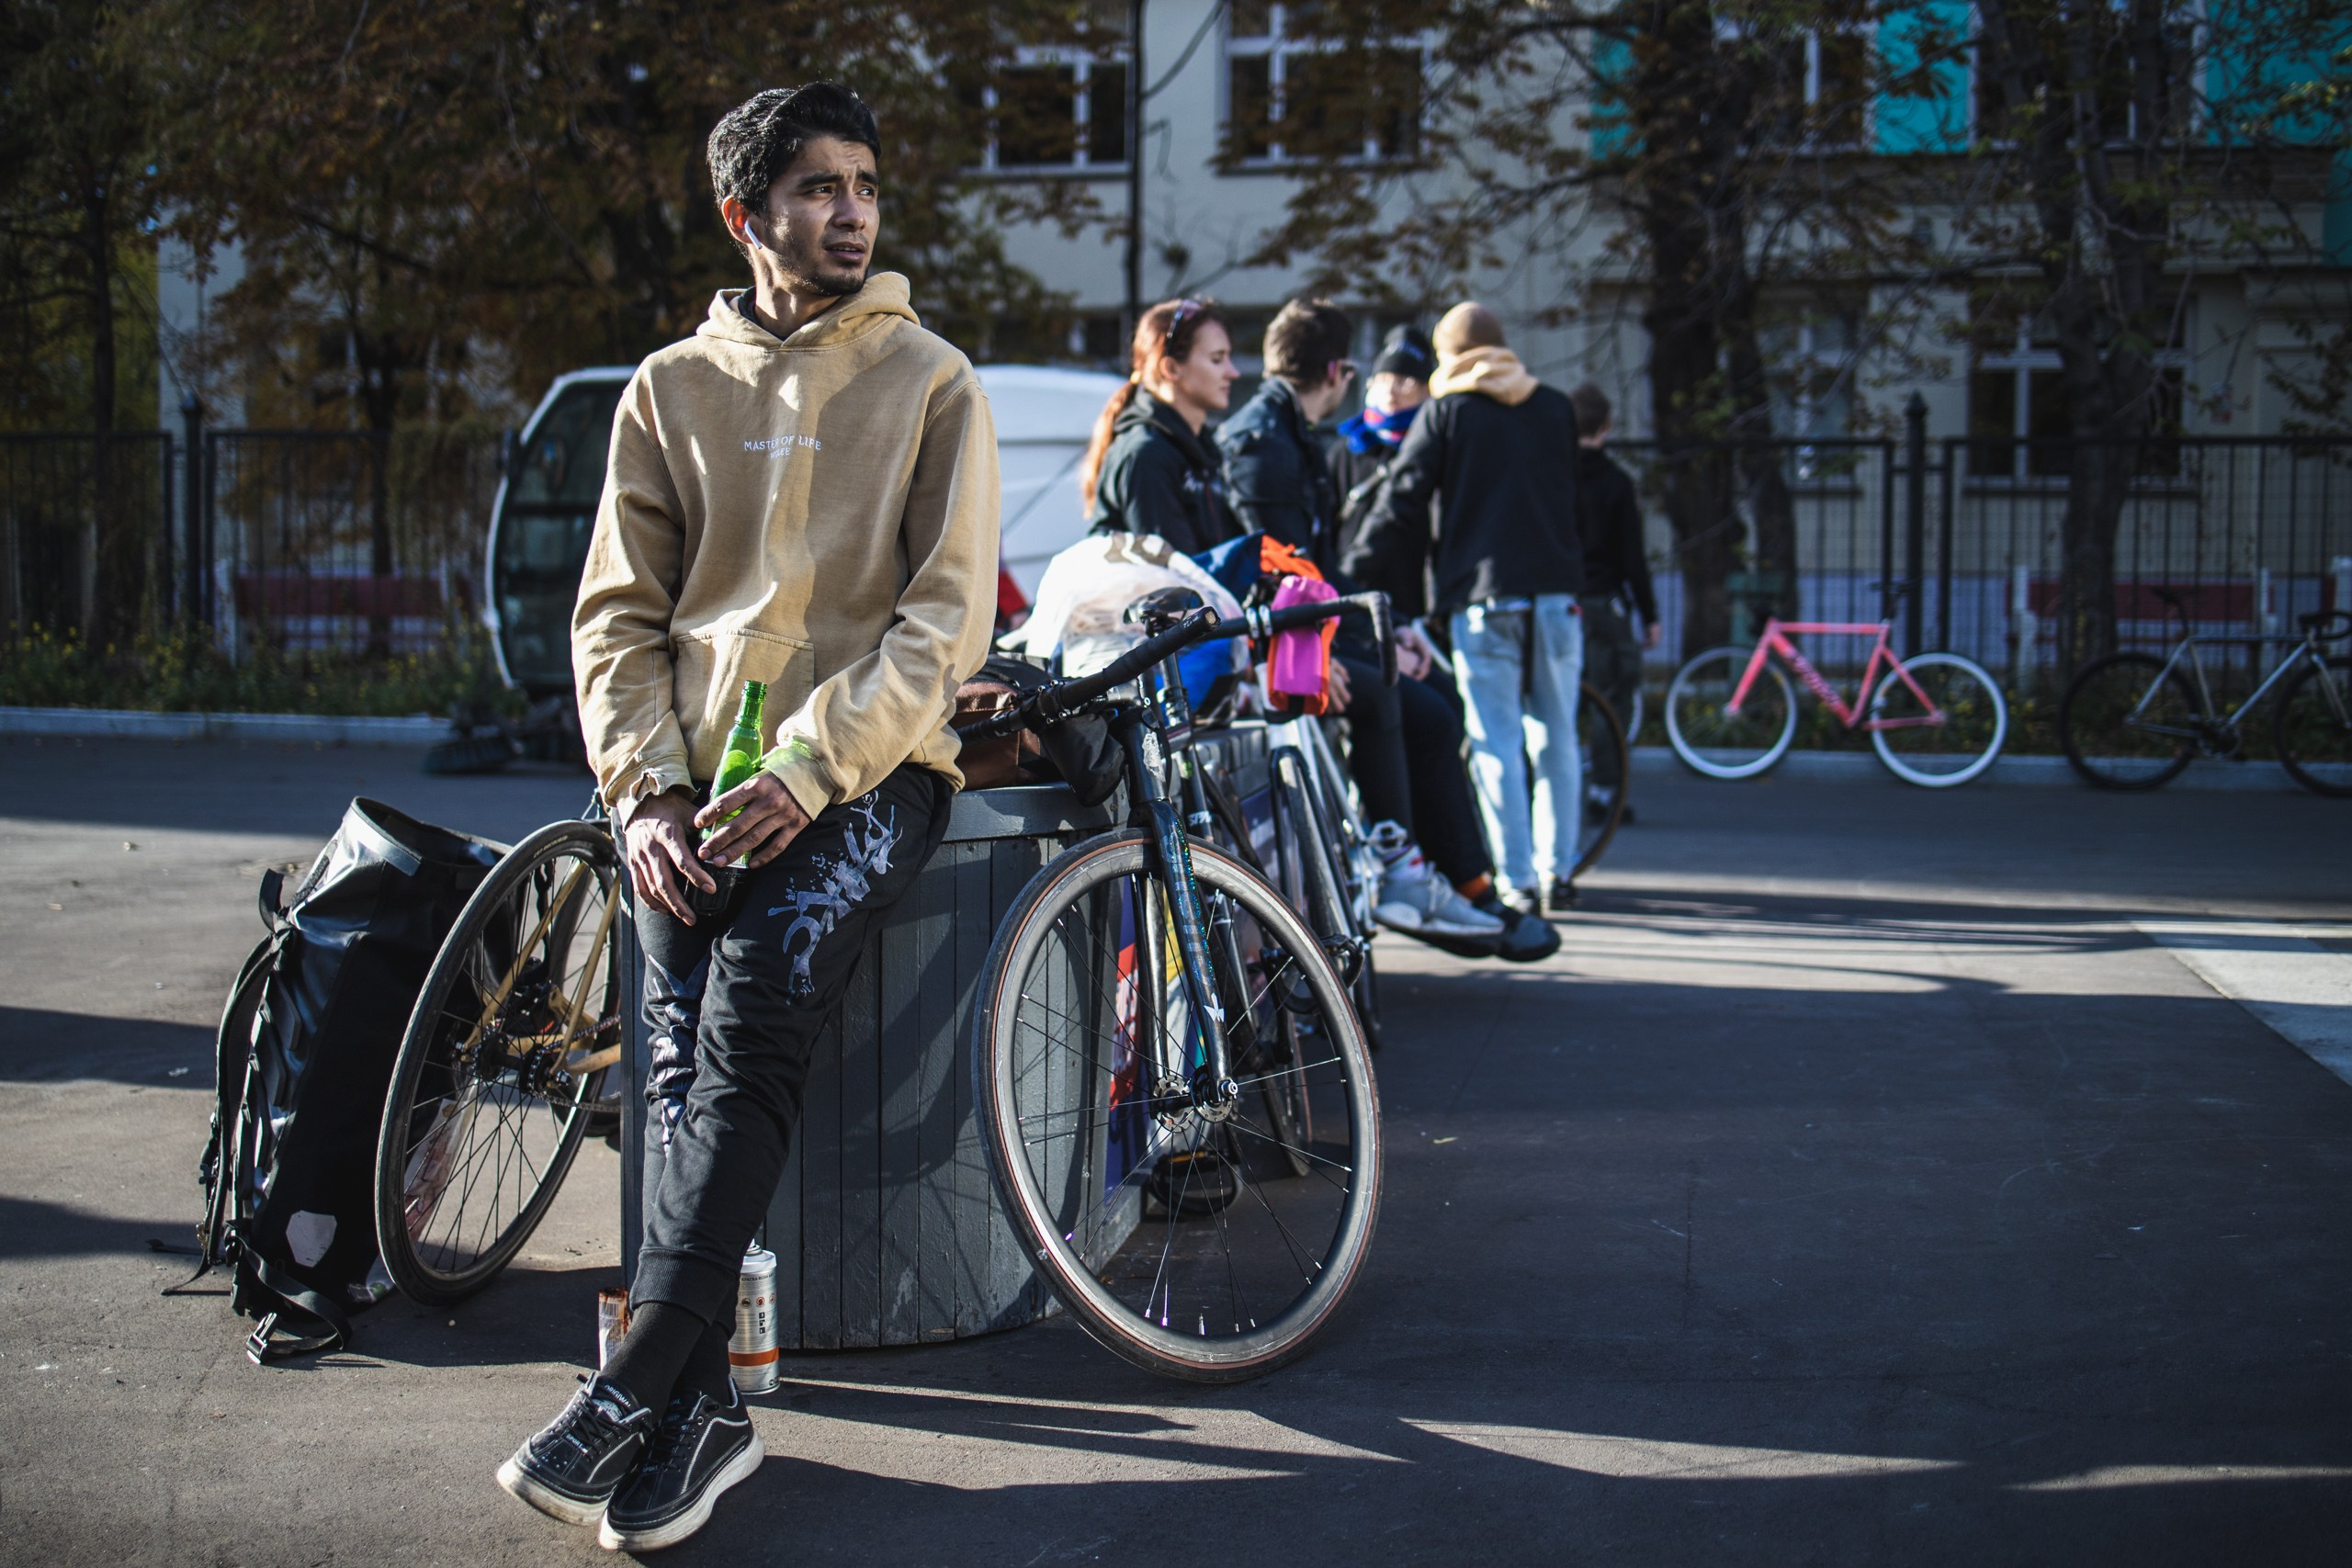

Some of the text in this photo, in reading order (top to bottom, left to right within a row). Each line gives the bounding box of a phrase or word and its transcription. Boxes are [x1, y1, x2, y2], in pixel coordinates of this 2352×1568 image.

[744, 434, 822, 451] MASTER OF LIFE
